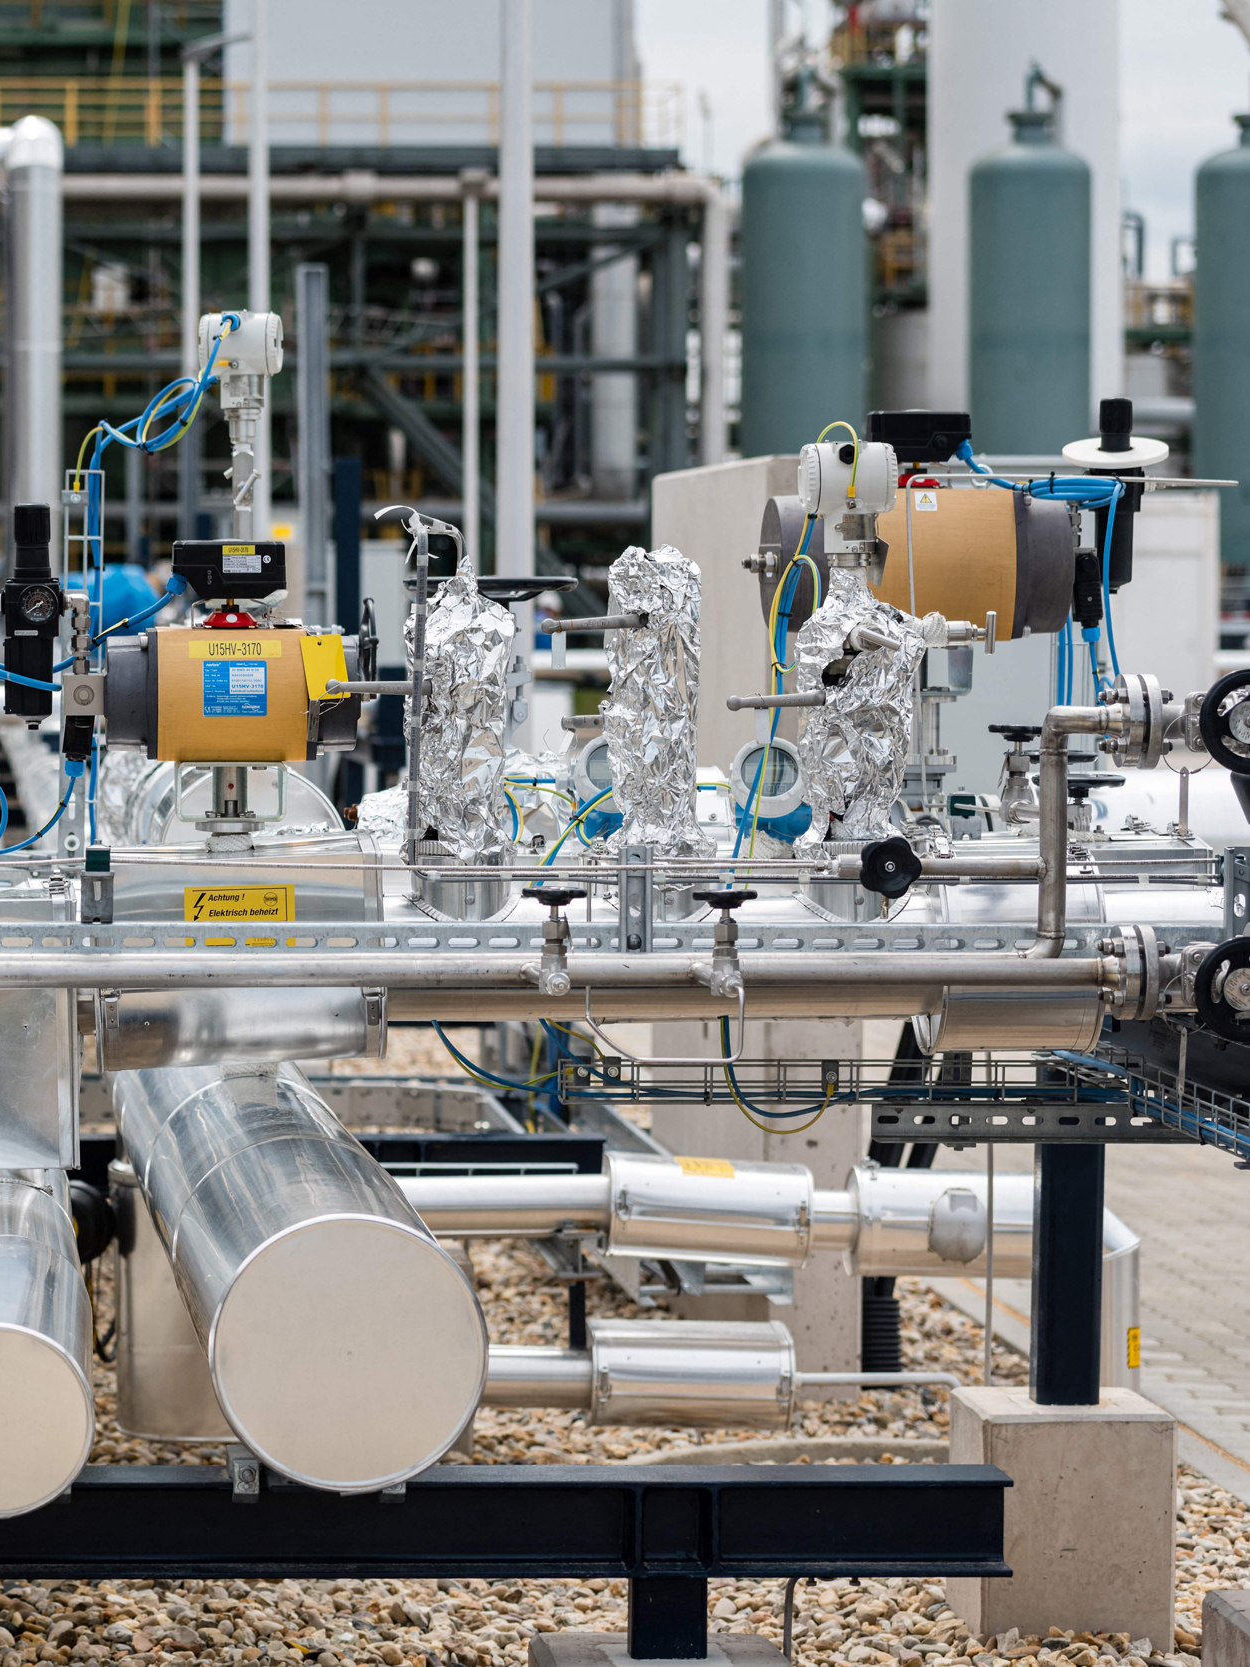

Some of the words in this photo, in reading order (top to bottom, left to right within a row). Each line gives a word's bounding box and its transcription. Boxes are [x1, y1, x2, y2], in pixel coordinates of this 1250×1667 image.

[208, 642, 262, 656] U15HV-3170
[208, 894, 240, 902] Achtung
[208, 908, 248, 917] Elektrisch
[249, 907, 279, 916] beheizt
